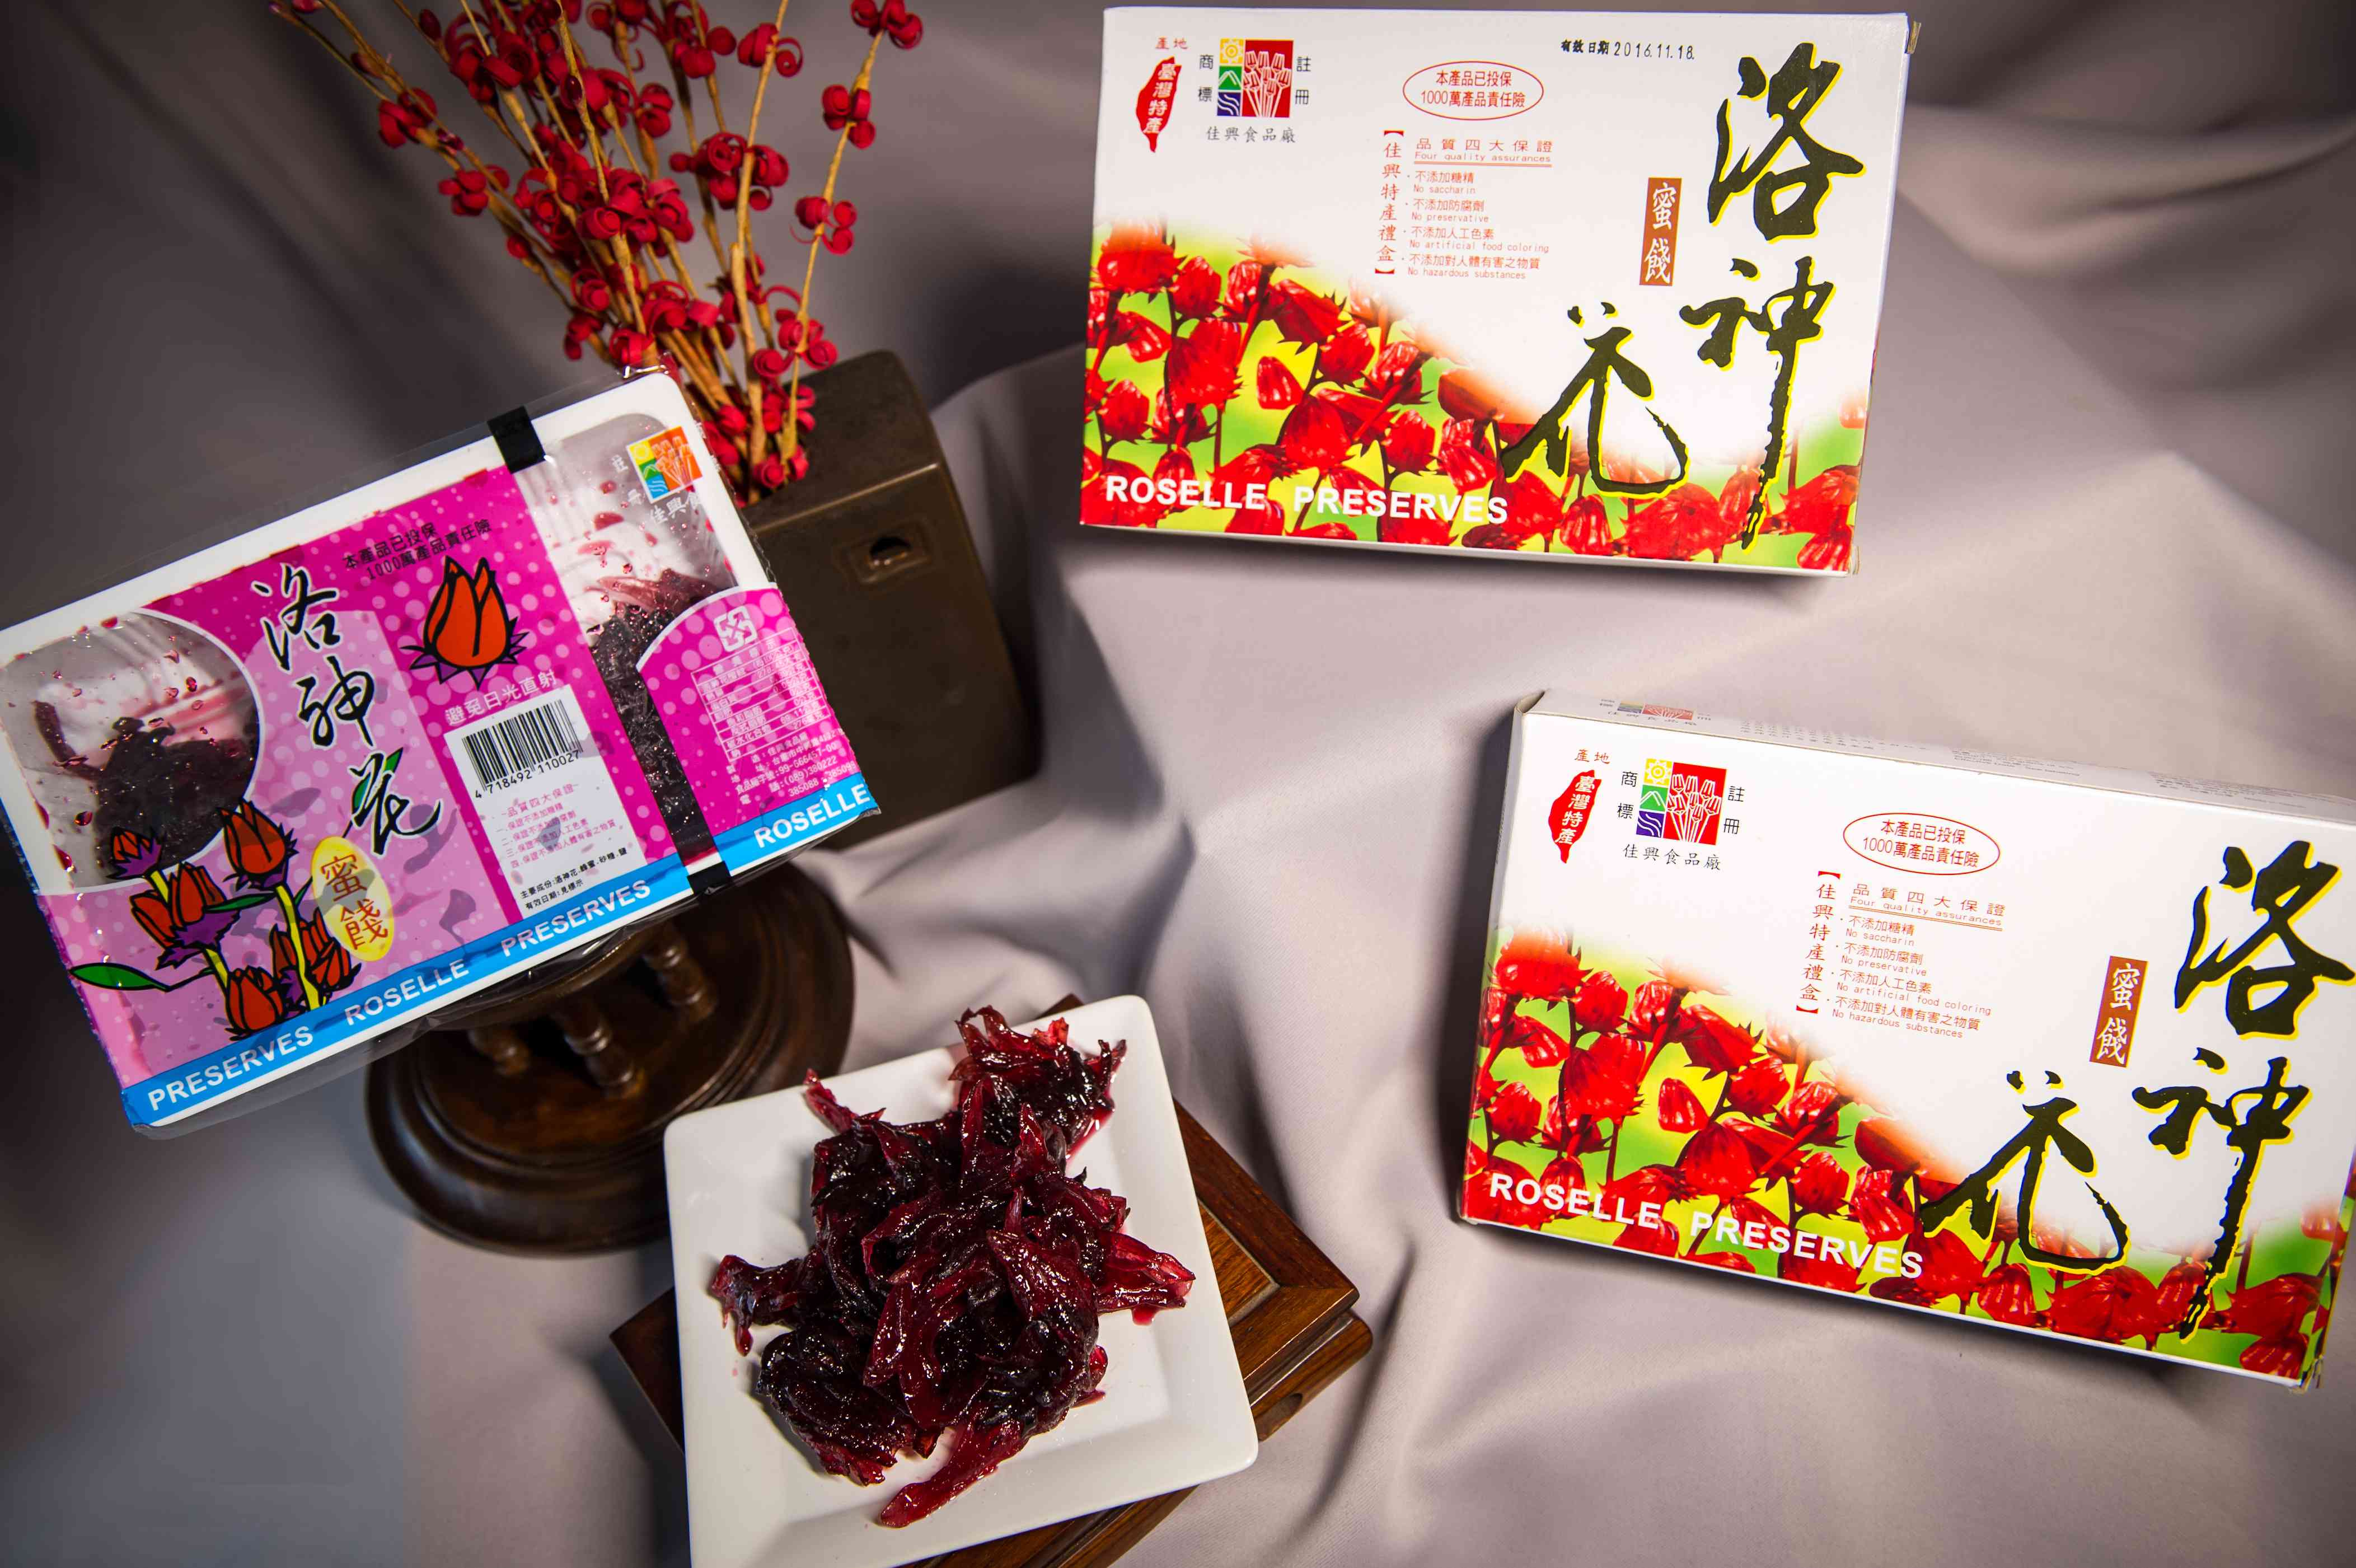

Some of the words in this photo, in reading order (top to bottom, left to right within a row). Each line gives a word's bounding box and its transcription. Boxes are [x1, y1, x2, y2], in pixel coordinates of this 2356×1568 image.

[1155, 36, 1188, 51] 產地
[1198, 54, 1214, 102] 商標
[1295, 57, 1312, 105] 註冊
[1436, 70, 1512, 87] 本產品已投保
[1421, 90, 1526, 108] 1000萬產品責任險
[1206, 127, 1296, 144] 佳興食品廠
[1416, 138, 1553, 153] 品質四大保證
[1414, 152, 1437, 160] Four
[1445, 152, 1486, 162] quality
[1413, 184, 1424, 193] No
[1429, 185, 1476, 195] saccharin
[1427, 214, 1489, 223] preservative
[1644, 182, 1677, 284] 蜜餞
[1425, 241, 1476, 251] artificial
[1483, 242, 1502, 251] food
[1507, 243, 1549, 254] coloring
[1407, 267, 1418, 275] No
[1423, 268, 1469, 278] hazardous
[1474, 269, 1526, 279] substances
[1106, 474, 1266, 511] ROSELLE
[1294, 485, 1509, 525] PRESERVES
[342, 522, 437, 570] 本產品已投保
[367, 518, 493, 580] 1000萬產品責任險
[444, 670, 556, 726] 避免日光直射
[1574, 748, 1611, 764] 產地
[1617, 771, 1638, 820] 商標
[1723, 785, 1745, 835] 註冊
[753, 783, 870, 848] ROSELLE
[1881, 819, 1966, 845] 本產品已投保
[1623, 843, 1721, 870] 佳興食品廠
[1863, 836, 1980, 868] 1000萬產品責任險
[320, 854, 388, 950] 蜜餞
[1850, 896, 1876, 907] Four
[1883, 901, 1929, 916] quality
[1935, 910, 2002, 926] assurances
[1853, 883, 2006, 917] 品質四大保證
[1846, 928, 1857, 938] No
[1863, 932, 1914, 946] saccharin
[1841, 954, 1853, 964] No
[1858, 958, 1927, 977] preservative
[147, 1026, 314, 1111] PRESERVES
[344, 959, 470, 1026] ROSELLE
[501, 879, 652, 957] PRESERVES
[1837, 982, 1848, 991] No
[1854, 984, 1909, 1001] artificial
[1917, 995, 1939, 1006] food
[1945, 1000, 1992, 1016] coloring
[1832, 1008, 1844, 1018] No
[1849, 1010, 1900, 1028] hazardous
[1906, 1022, 1963, 1038] substances
[2096, 963, 2140, 1065] 蜜餞
[1490, 1172, 1662, 1230] ROSELLE
[1690, 1211, 1924, 1280] PRESERVES
